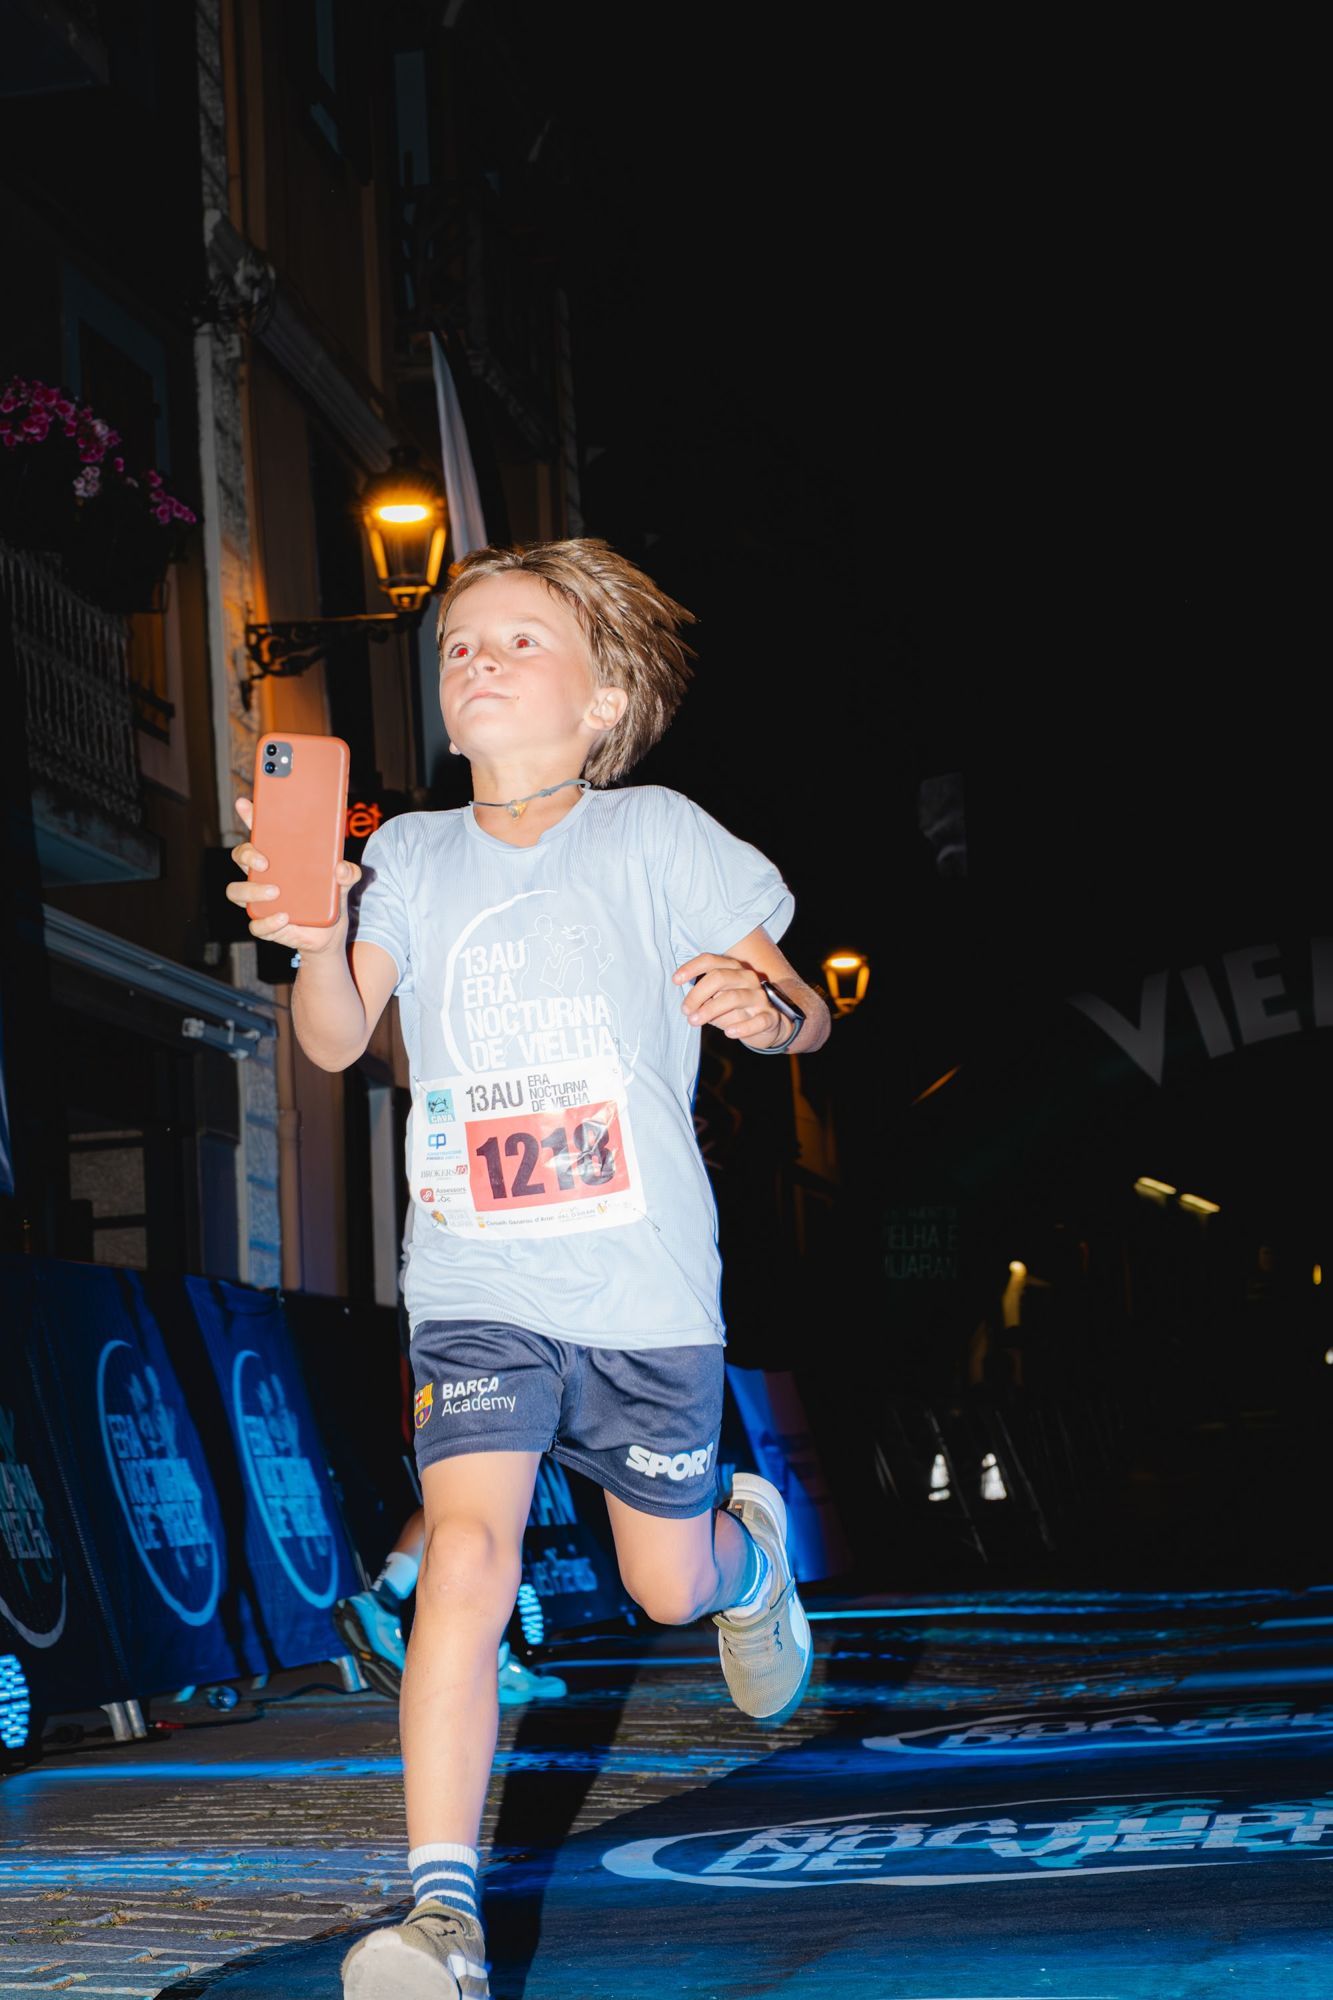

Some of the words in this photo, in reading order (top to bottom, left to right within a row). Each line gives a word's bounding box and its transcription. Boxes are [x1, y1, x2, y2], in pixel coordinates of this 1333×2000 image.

[459, 939, 526, 977] 13AU
[461, 972, 517, 1009] ERA
[464, 994, 612, 1041] NOCTURNA
[468, 1034, 508, 1073] DE
[518, 1026, 616, 1065] VIELHA
[465, 1080, 524, 1112] 13AU
[527, 1073, 551, 1087] ERA
[529, 1080, 588, 1100] NOCTURNA
[531, 1099, 546, 1112] DE
[551, 1092, 590, 1107] VIELHA
[476, 1117, 616, 1200] 1218
[442, 1376, 499, 1400] BARÇA
[442, 1393, 517, 1417] Academy
